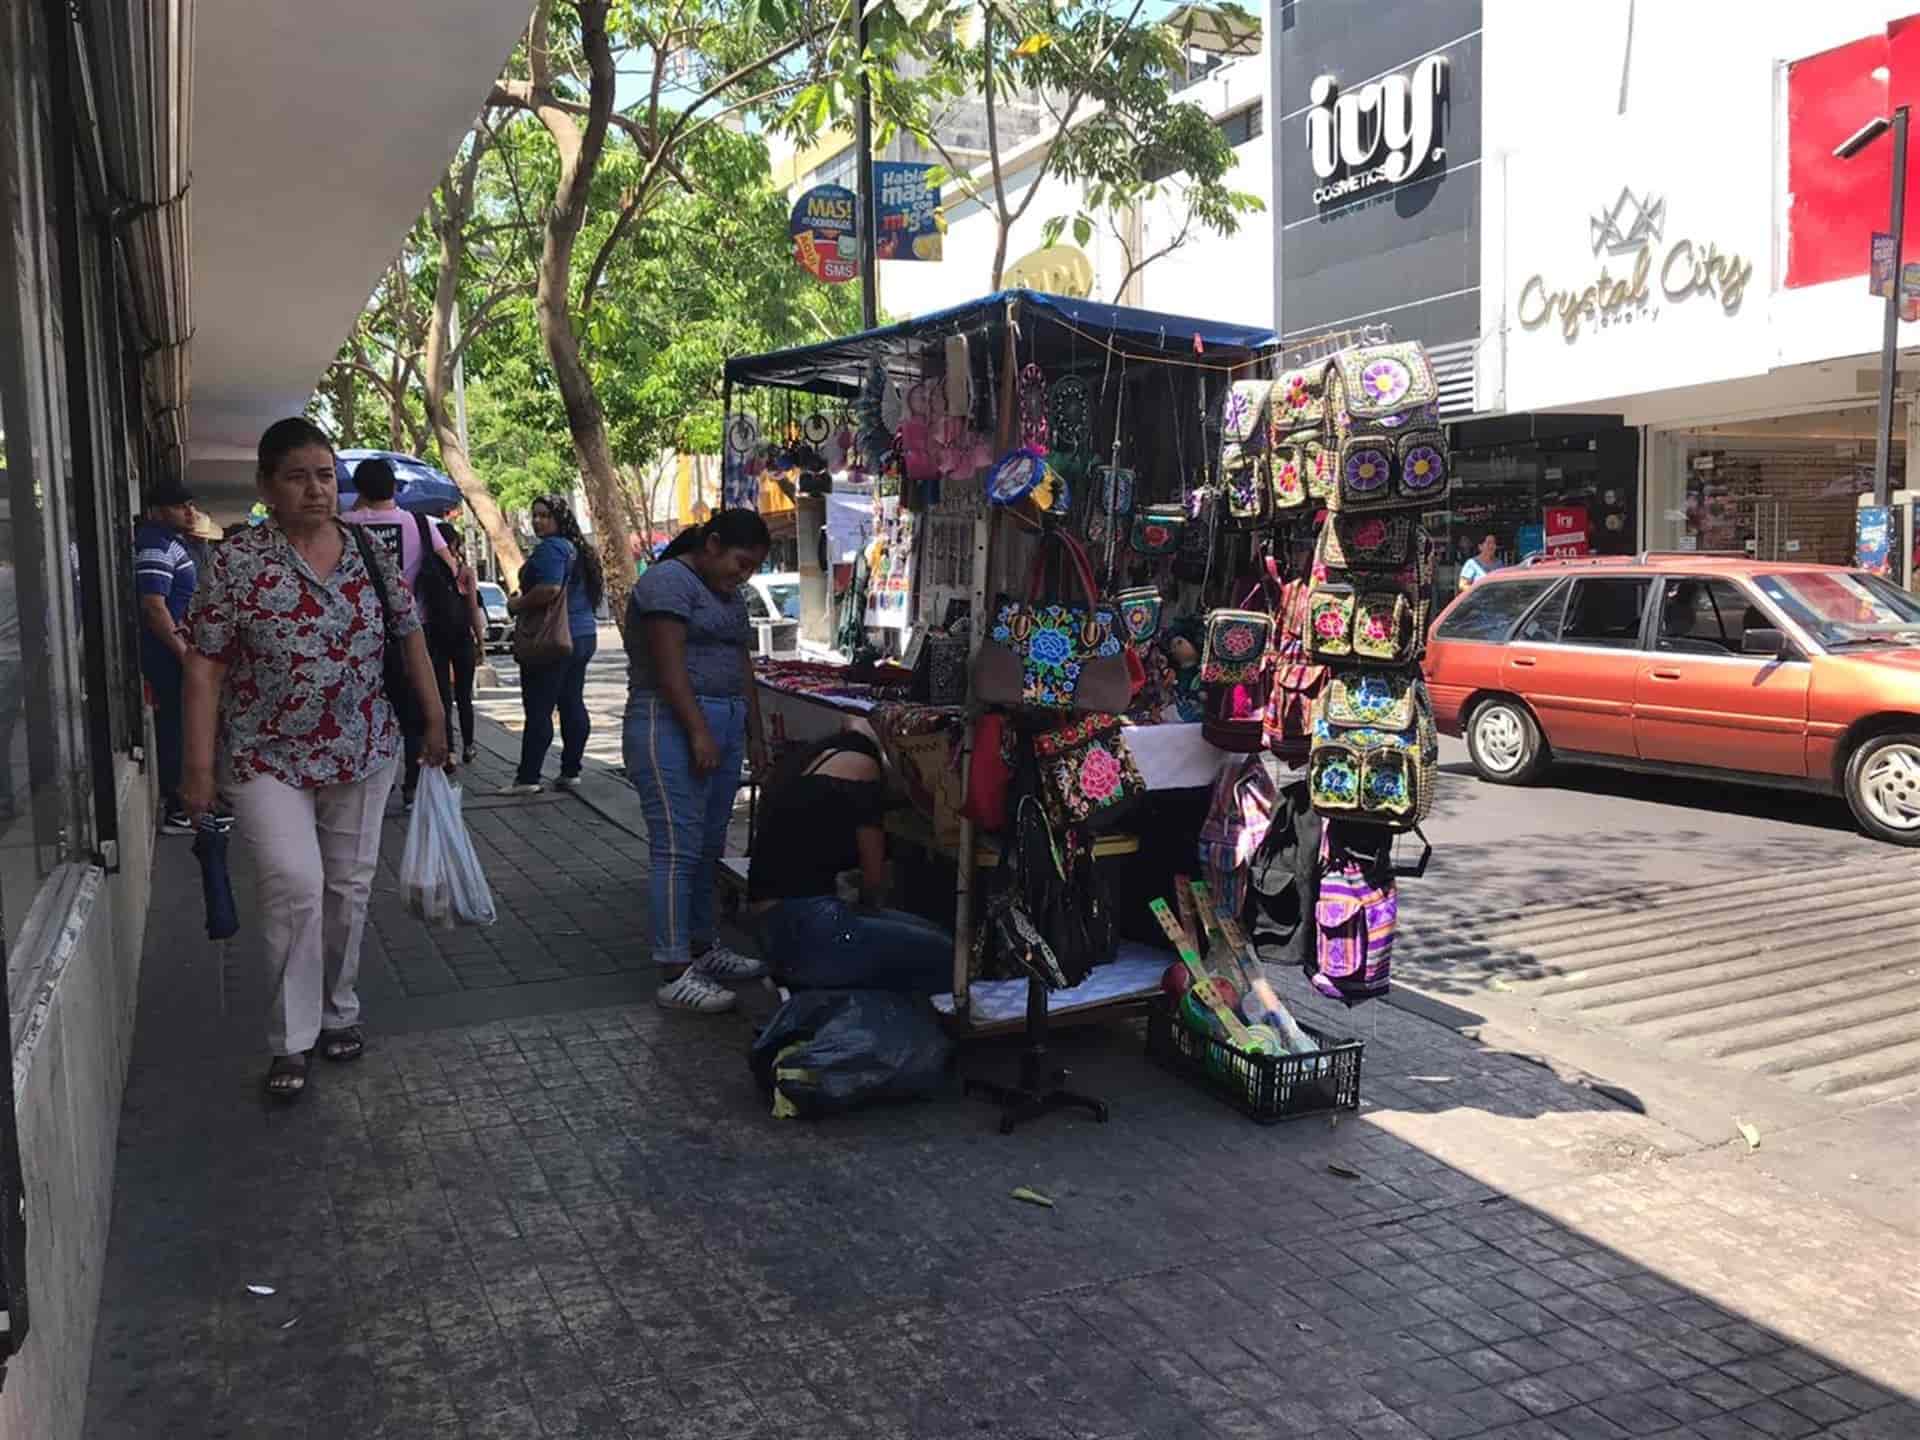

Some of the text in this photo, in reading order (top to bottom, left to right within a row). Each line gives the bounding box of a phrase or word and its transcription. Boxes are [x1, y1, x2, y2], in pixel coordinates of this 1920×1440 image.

[1312, 164, 1391, 204] COSMETICS
[824, 263, 854, 278] SMS
[1518, 238, 1752, 343] Crystal City
